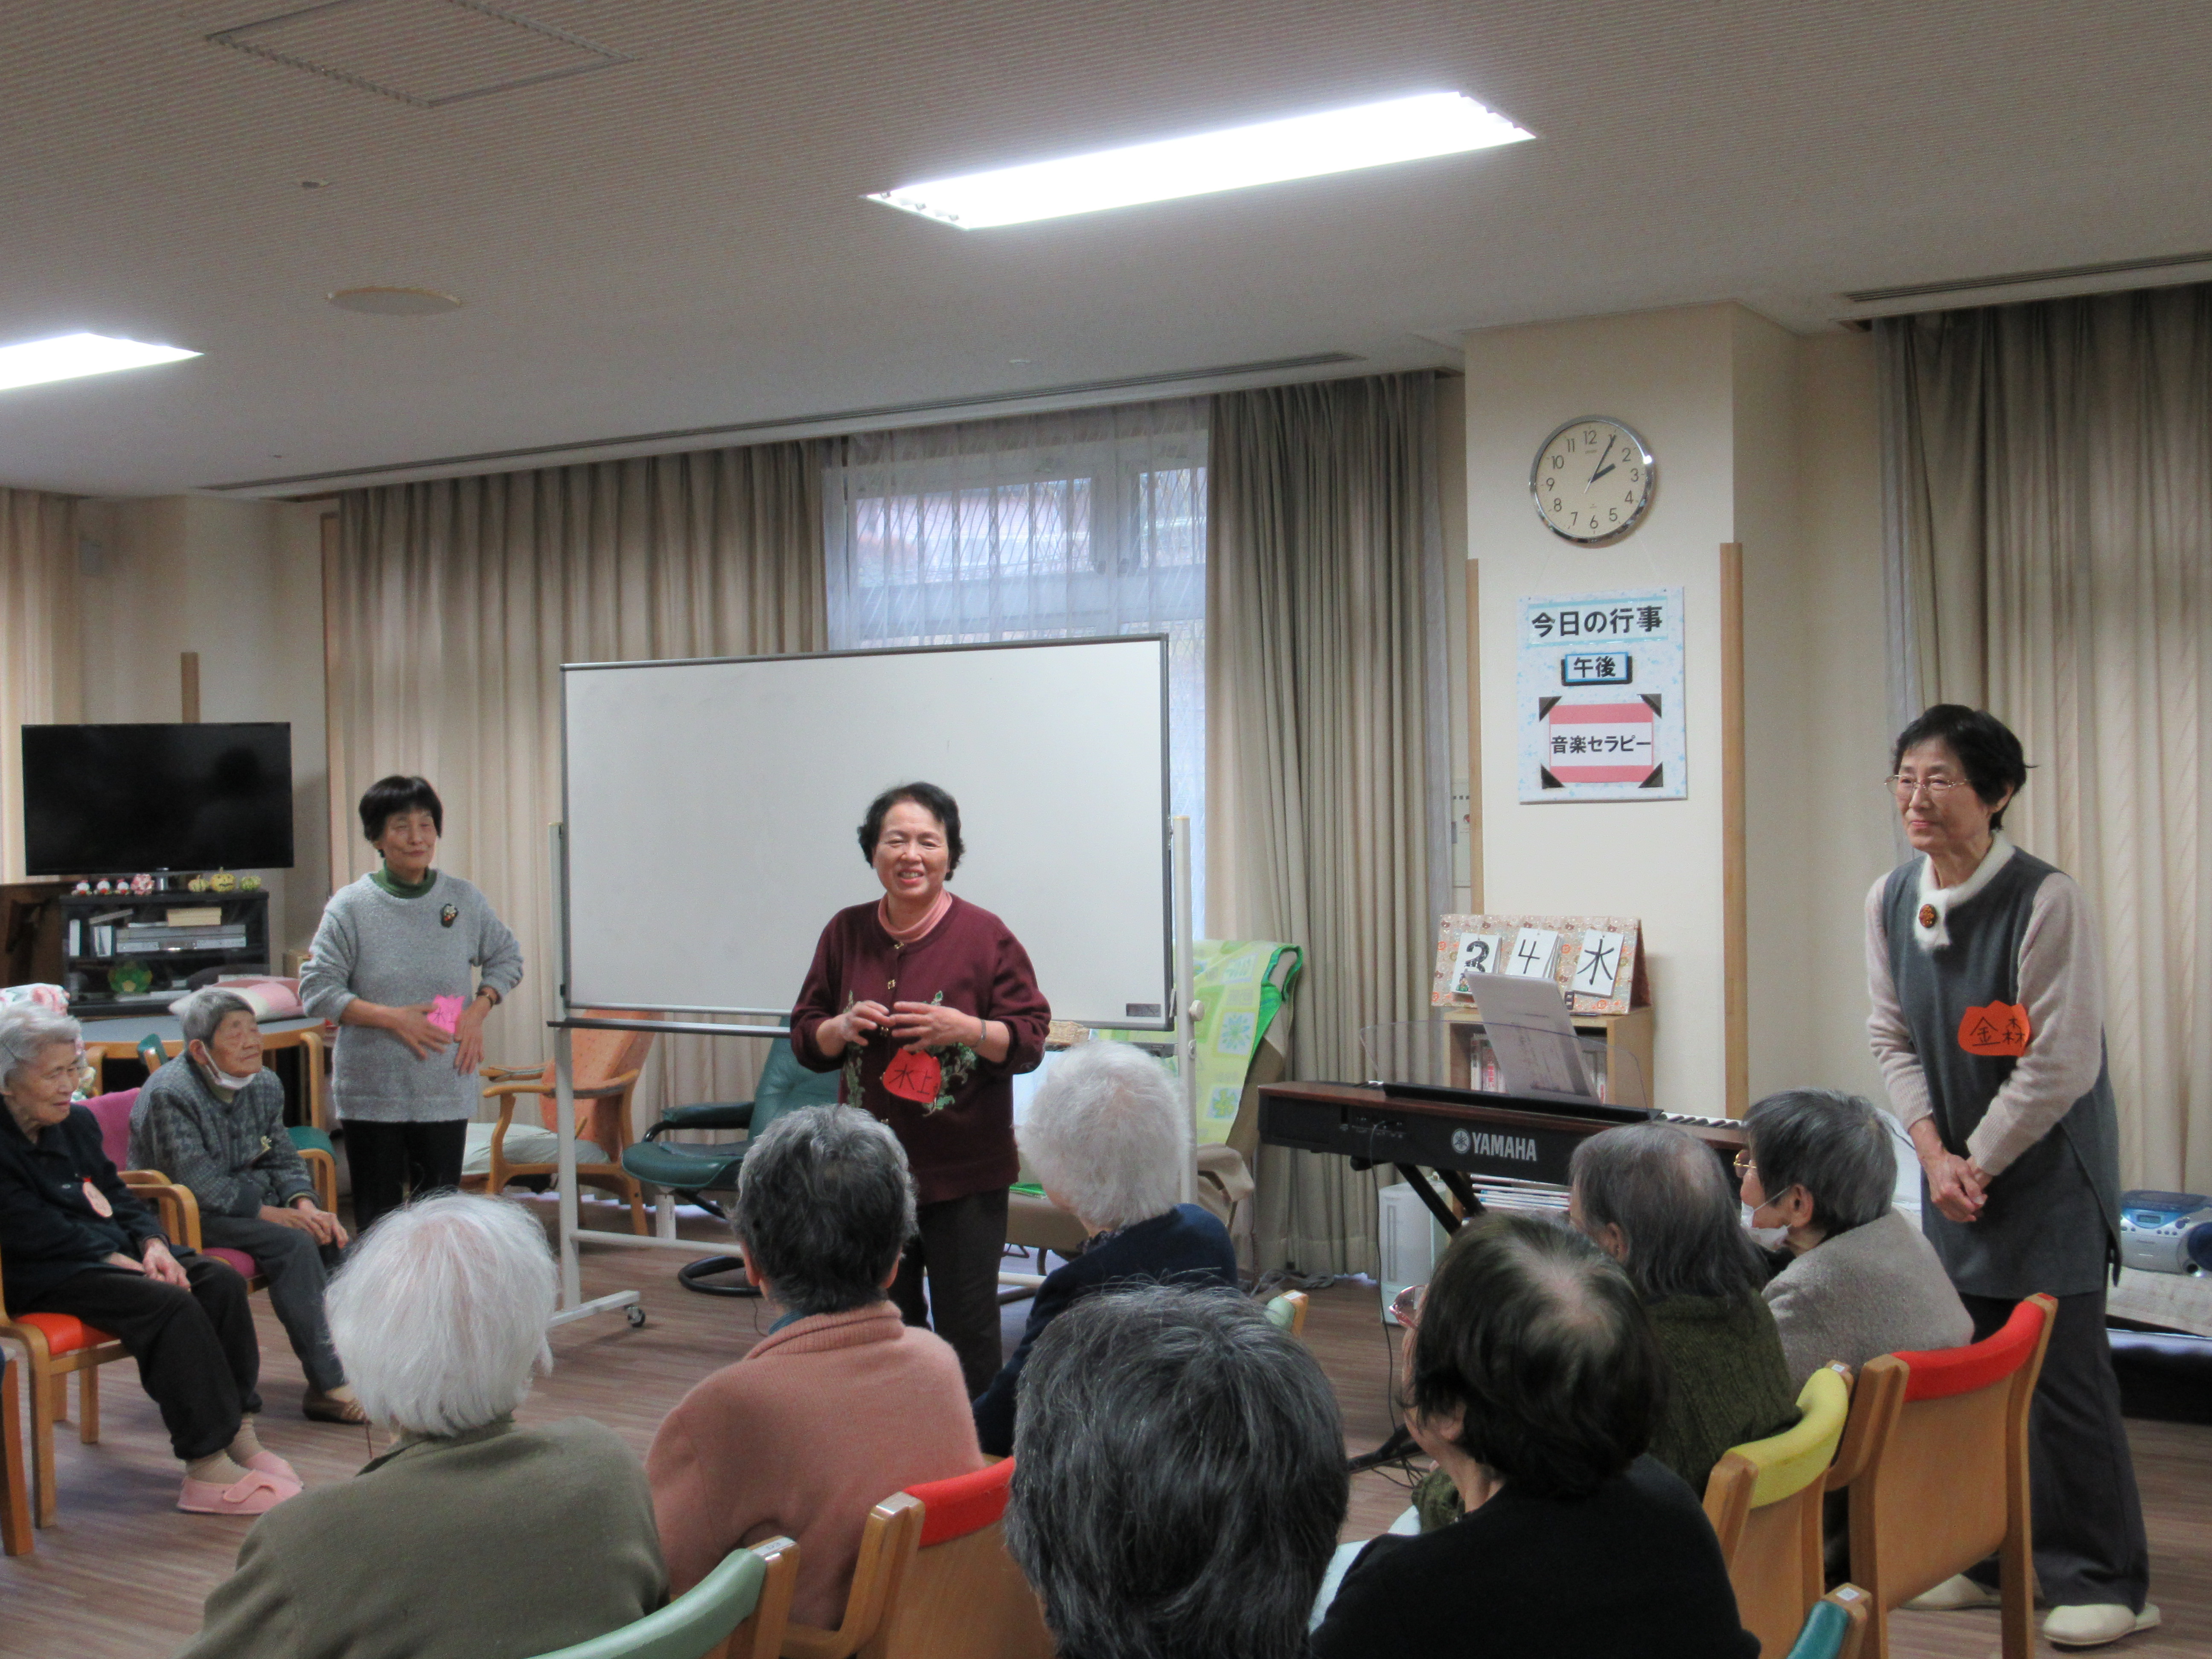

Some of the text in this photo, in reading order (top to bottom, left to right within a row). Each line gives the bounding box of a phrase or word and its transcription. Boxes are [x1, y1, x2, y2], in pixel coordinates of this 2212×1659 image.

[1583, 430, 1597, 445] 12
[1567, 438, 1575, 452] 11
[1622, 447, 1631, 462] 2
[1551, 455, 1564, 469] 10
[1630, 468, 1639, 482] 3
[1546, 477, 1555, 491] 9
[1625, 490, 1633, 504] 4
[1554, 498, 1562, 512] 8
[1571, 512, 1578, 526] 7
[1609, 508, 1618, 521] 5
[1589, 515, 1598, 529] 6
[1531, 605, 1662, 637] 今日の行事
[1573, 656, 1616, 678] 午後
[1551, 734, 1651, 754] 音楽セラピー
[1517, 939, 1540, 974] 4
[1576, 938, 1615, 985] 水
[1970, 1015, 2026, 1048] 金森
[1472, 1132, 1537, 1161] YAMAHA
